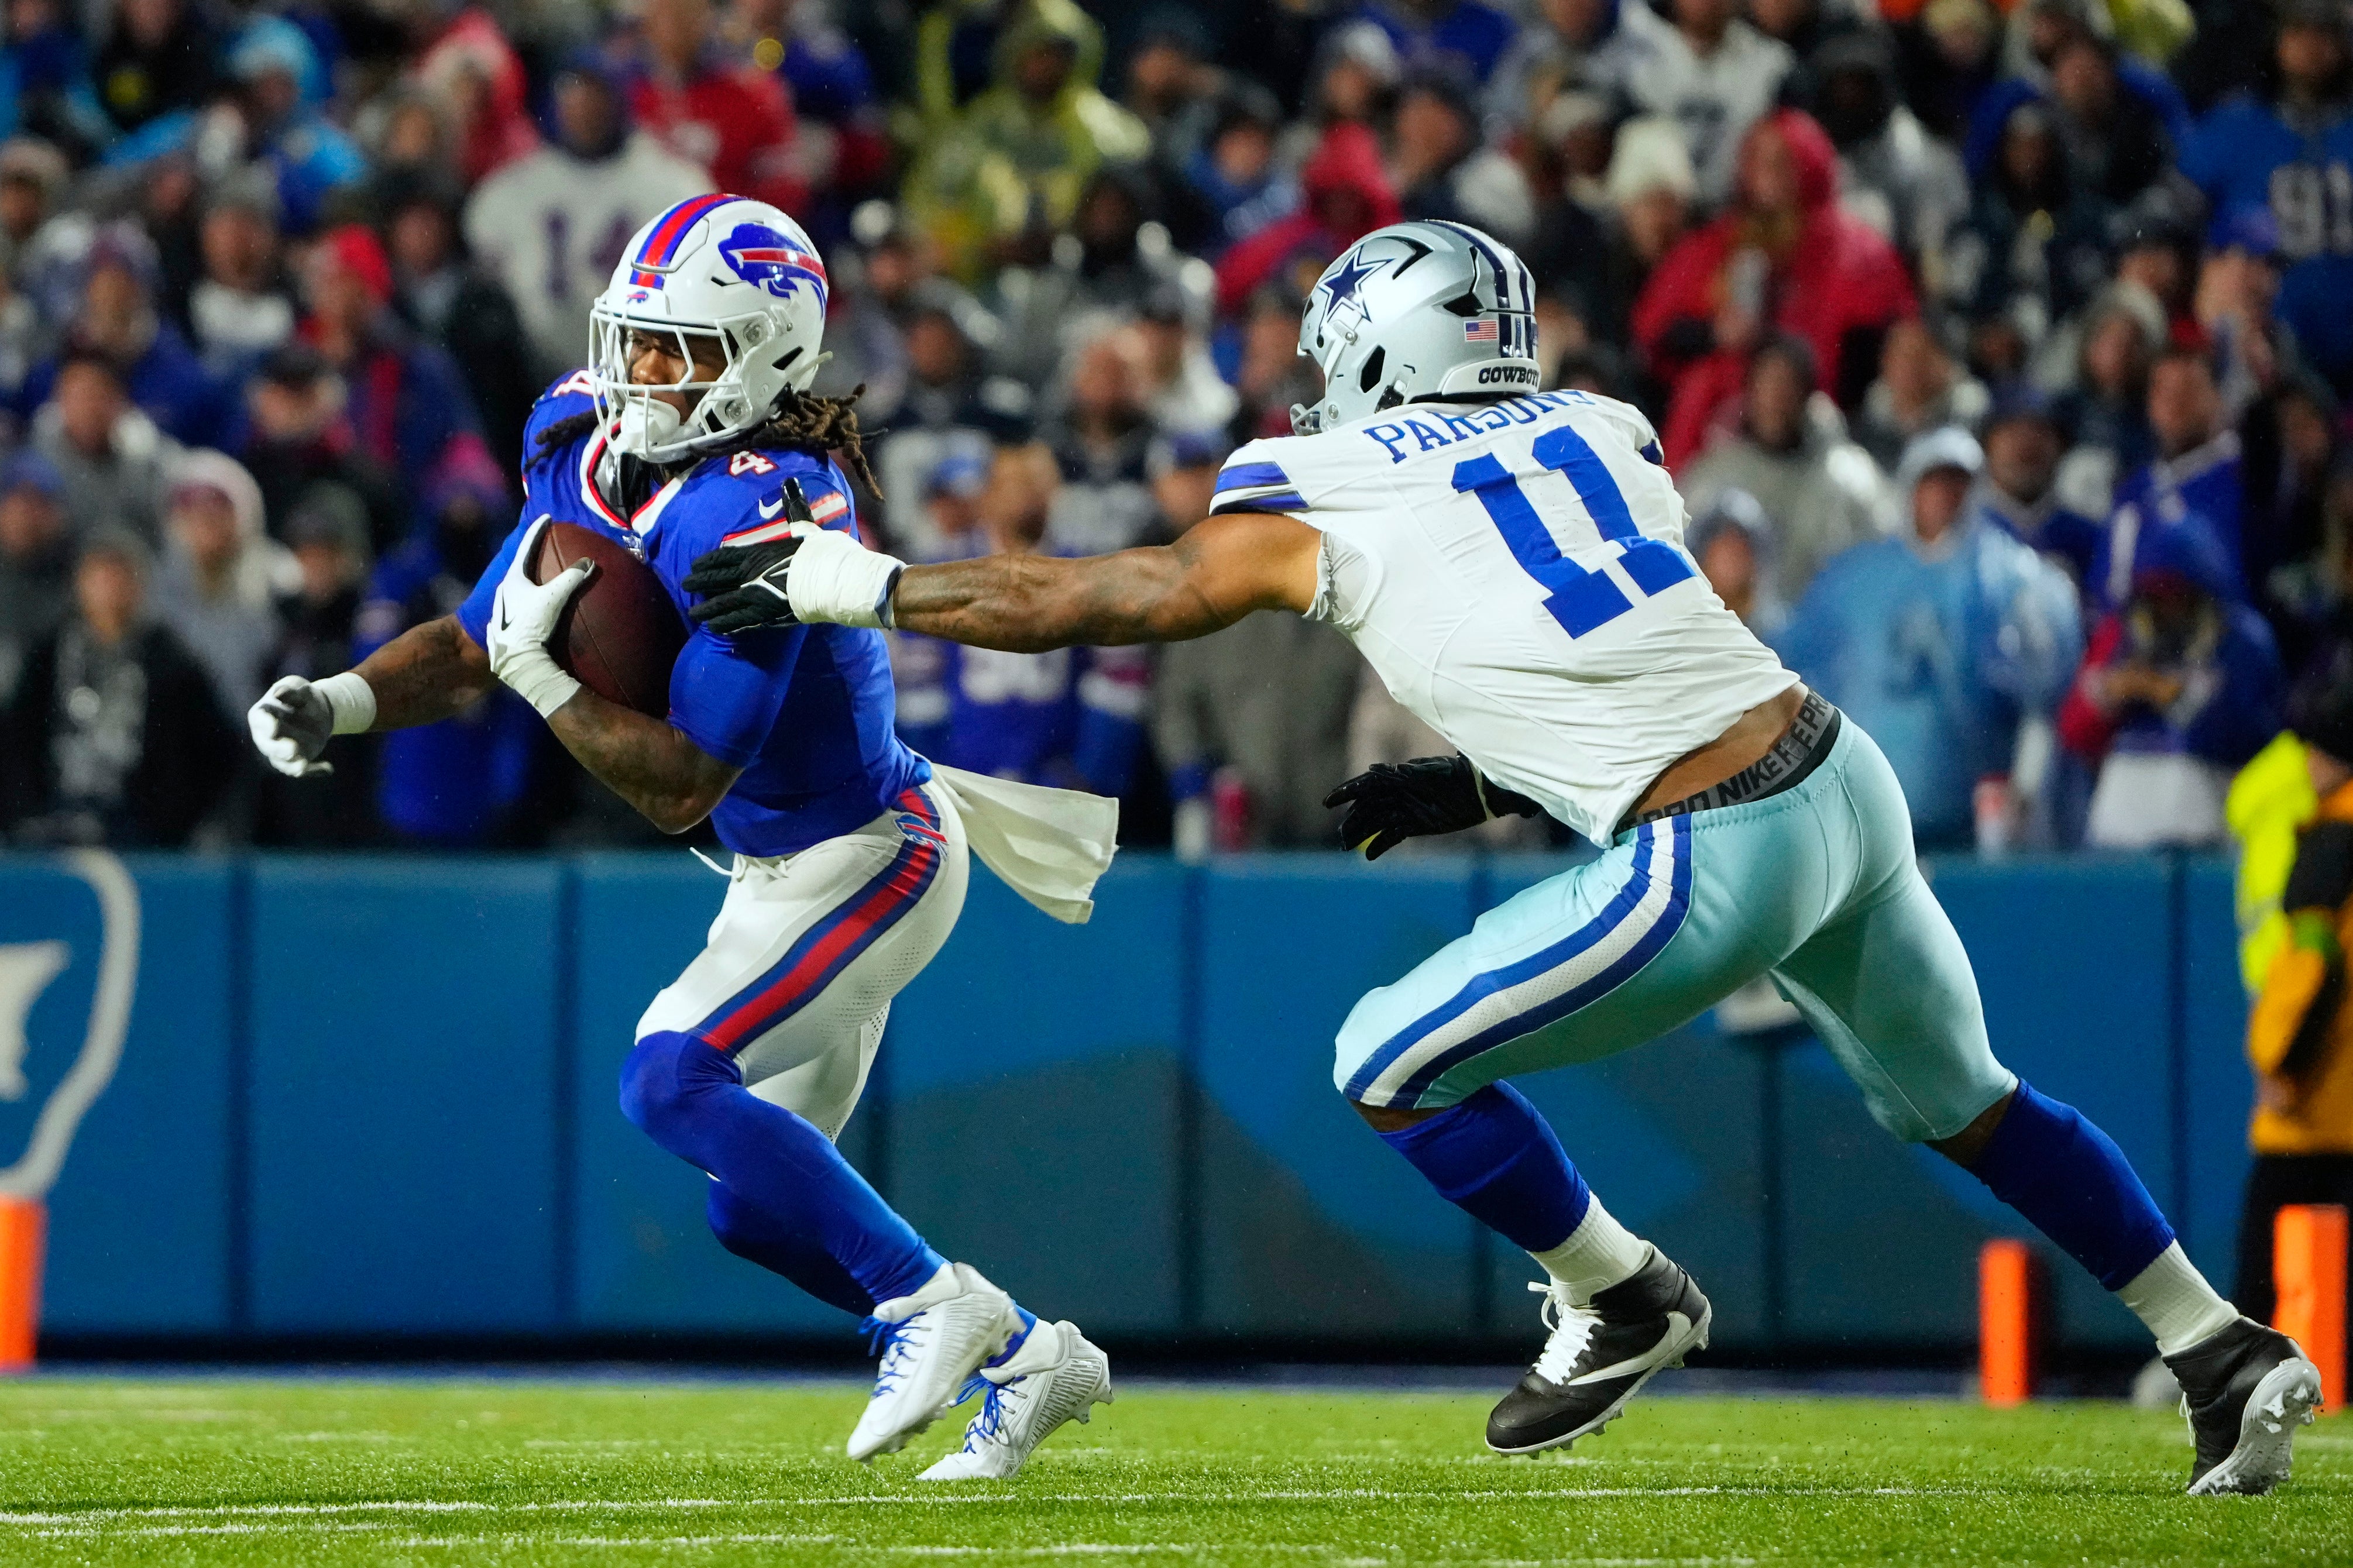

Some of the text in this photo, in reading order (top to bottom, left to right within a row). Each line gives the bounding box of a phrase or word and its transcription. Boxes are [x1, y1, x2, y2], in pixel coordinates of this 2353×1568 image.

[1478, 366, 1539, 387] COWBOY
[729, 450, 779, 477] 4
[1451, 425, 1696, 639] 11
[1716, 754, 1784, 806] NIKE
